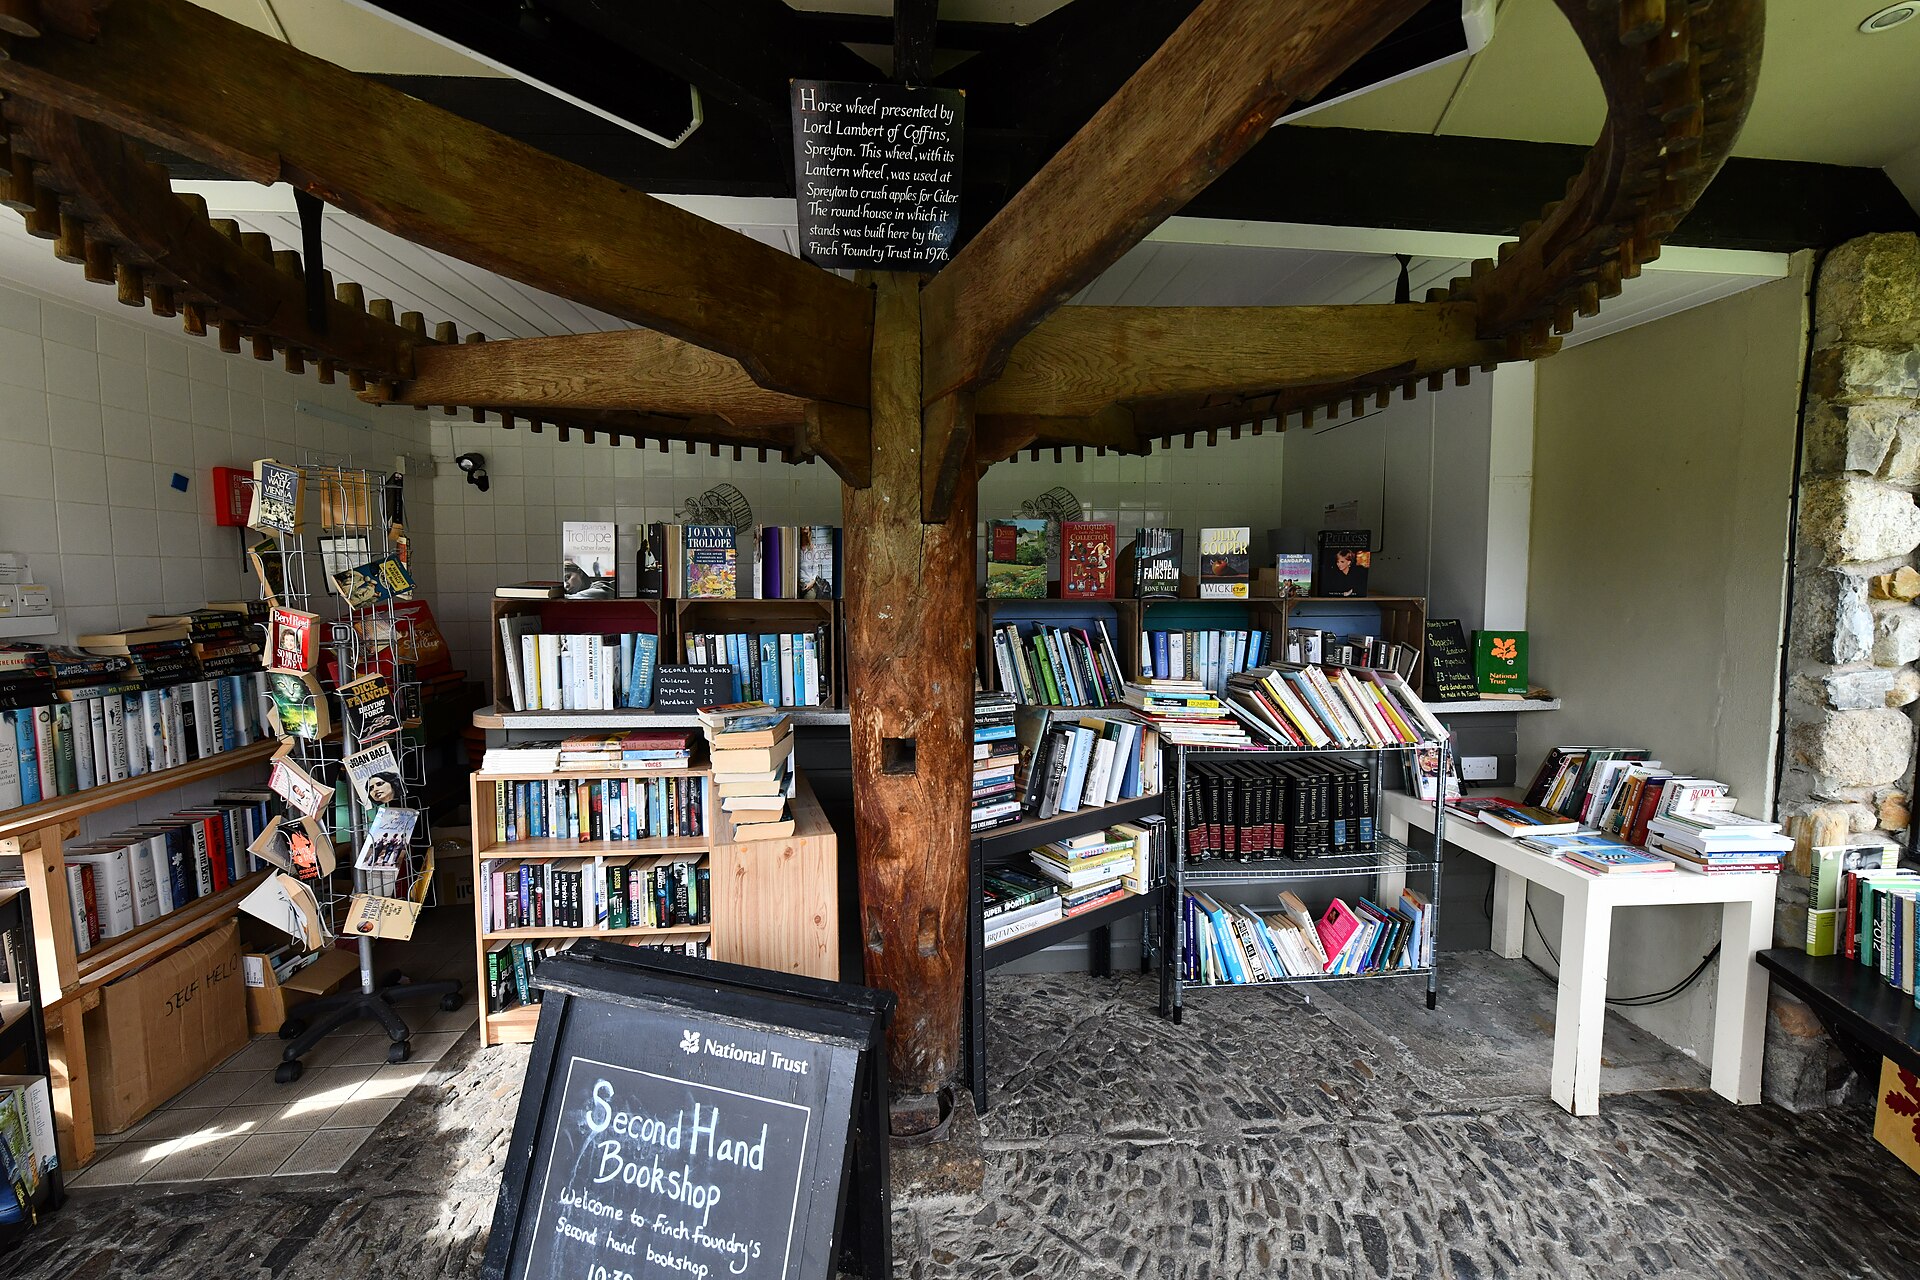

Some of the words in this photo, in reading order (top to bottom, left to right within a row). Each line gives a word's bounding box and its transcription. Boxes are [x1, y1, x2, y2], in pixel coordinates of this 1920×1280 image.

[800, 88, 842, 112] Horse
[846, 97, 880, 115] wheel
[881, 104, 938, 119] presented
[940, 104, 954, 125] by
[803, 119, 832, 134] Lord
[836, 121, 884, 137] Lambert
[887, 124, 901, 143] of
[904, 124, 950, 144] Coffins,
[805, 141, 856, 161] Spreyton.
[860, 142, 881, 158] This
[919, 147, 941, 162] with
[943, 150, 954, 162] its
[805, 162, 849, 177] Lantern
[891, 170, 910, 181] was
[914, 169, 937, 182] used
[940, 174, 952, 182] at
[807, 182, 848, 202] Spreyton
[850, 186, 858, 198] to
[861, 185, 887, 199] crush
[889, 186, 917, 203] apples
[915, 190, 933, 205] for
[934, 189, 959, 203] Cider.
[808, 202, 827, 216] The
[895, 208, 904, 219] in
[907, 206, 936, 222] which
[939, 211, 949, 222] it
[810, 224, 840, 236] stands
[843, 228, 861, 237] was
[864, 223, 885, 239] built
[887, 223, 908, 239] here
[912, 227, 925, 245] by
[928, 226, 943, 241] the
[809, 241, 838, 255] Finch
[841, 243, 884, 262] Foundry
[885, 245, 910, 259] Trust
[913, 247, 922, 259] in
[925, 248, 949, 263] 1976.
[270, 470, 289, 480] LAST
[566, 530, 612, 549] Trollope
[688, 527, 732, 537] JOANNA
[1212, 529, 1239, 541] JILLY
[688, 538, 732, 548] TROLLOPE
[1202, 541, 1248, 556] COOPER
[1143, 568, 1179, 580] FAIRSTEIN
[1152, 560, 1172, 569] LINDA
[274, 610, 293, 625] Beryl
[292, 614, 310, 628] Reid
[277, 650, 287, 659] SO
[281, 658, 297, 669] LOVE
[157, 664, 169, 672] GET
[169, 662, 182, 671] EVEN
[710, 666, 731, 674] Books
[118, 683, 141, 693] MURDER
[352, 680, 377, 697] DICK
[704, 677, 714, 685] £1
[211, 688, 222, 701] ACT
[347, 686, 390, 708] FRANCIS
[113, 701, 122, 727] PENNY
[150, 693, 158, 719] RIVERS
[212, 706, 221, 718] OF
[358, 699, 386, 715] DRIVING
[364, 706, 385, 719] FORCE
[214, 719, 224, 743] WILL
[63, 733, 72, 762] HOWARD
[117, 727, 126, 768] VINCENZI
[349, 751, 369, 769] JOAN
[369, 745, 390, 760] BAEZ
[353, 760, 394, 780] DAYBREAK
[644, 760, 662, 768] VOICES
[1054, 743, 1067, 783] ROSEBERY
[1187, 793, 1196, 826] Britannica
[1195, 789, 1204, 821] Britannica
[1226, 790, 1234, 822] Britannica
[1362, 783, 1370, 815] Britannica
[196, 829, 205, 840] TO
[198, 840, 206, 852] BE
[199, 852, 207, 864] THE
[200, 864, 209, 886] BEST
[613, 867, 621, 890] LARSSON
[1810, 865, 1819, 886] JUNGLE
[984, 907, 1002, 919] SUPER
[1004, 898, 1025, 911] SPORTS
[1810, 887, 1819, 910] DOCTOR
[1807, 912, 1817, 945] PANORAMA
[165, 977, 199, 1017] SELF
[703, 1038, 766, 1066] National
[770, 1052, 809, 1075] Trust
[32, 1088, 41, 1100] the
[33, 1100, 43, 1114] last
[35, 1115, 46, 1137] valley
[586, 1080, 684, 1151] Second
[689, 1102, 768, 1172] Hand
[593, 1139, 721, 1227] Bookshop
[560, 1187, 624, 1221] Welcome
[630, 1210, 644, 1228] to
[652, 1214, 689, 1240] Finch
[691, 1225, 761, 1275] Foundry's
[555, 1216, 597, 1245] Second
[606, 1232, 636, 1257] hand
[646, 1242, 714, 1280] bookshop.
